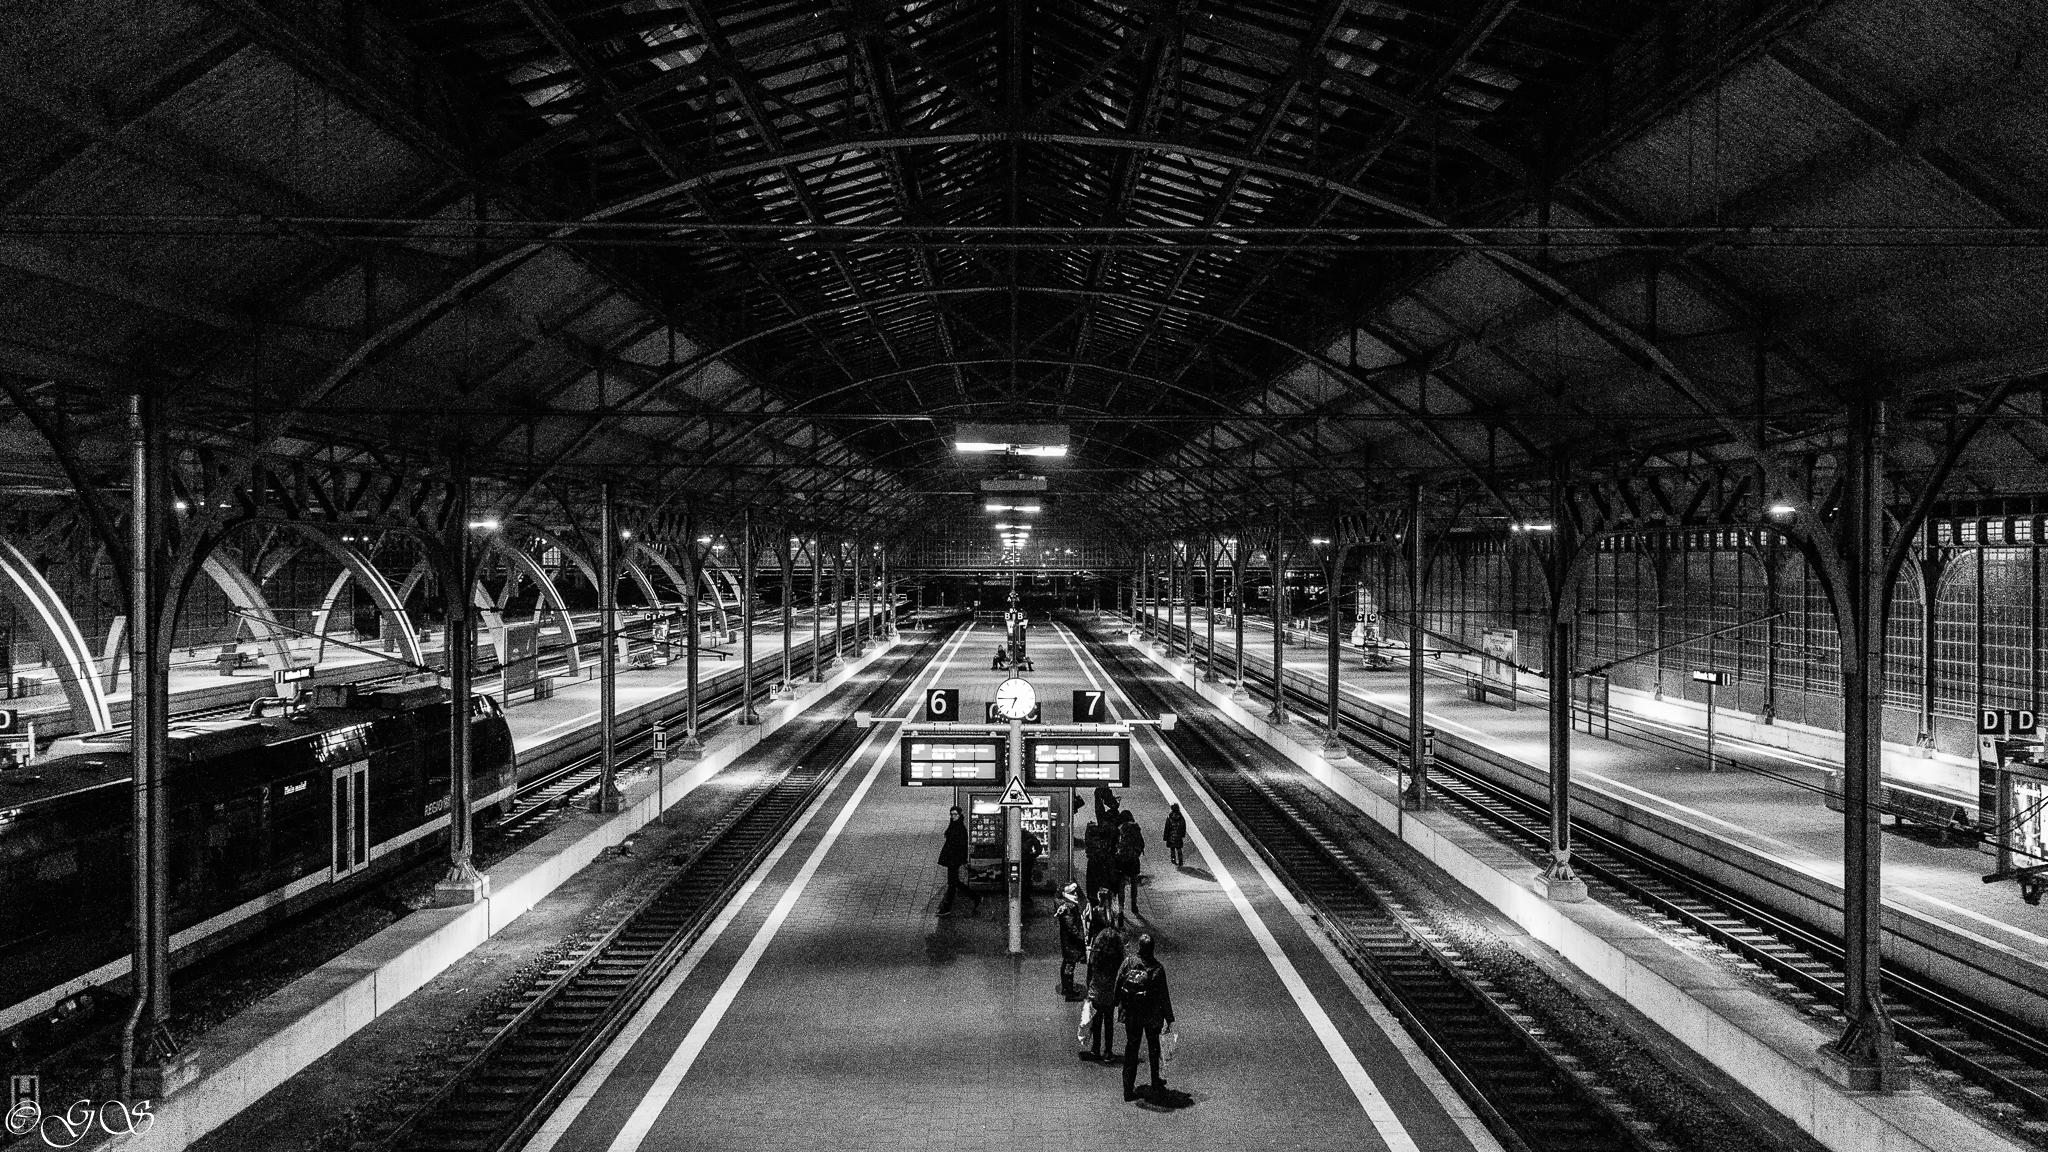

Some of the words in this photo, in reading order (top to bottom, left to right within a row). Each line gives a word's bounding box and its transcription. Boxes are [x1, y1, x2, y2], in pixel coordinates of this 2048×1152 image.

[645, 613, 651, 621] C
[1004, 612, 1010, 620] B
[1017, 612, 1023, 620] B
[1356, 613, 1363, 622] C
[1369, 613, 1376, 622] C
[771, 685, 777, 694] H
[930, 689, 947, 715] 6
[1085, 691, 1102, 716] 7
[1983, 711, 1999, 730] D
[2019, 711, 2034, 730] D
[654, 733, 666, 749] H
[1423, 738, 1433, 755] H
[262, 786, 270, 805] 2
[424, 799, 443, 817] REGIO
